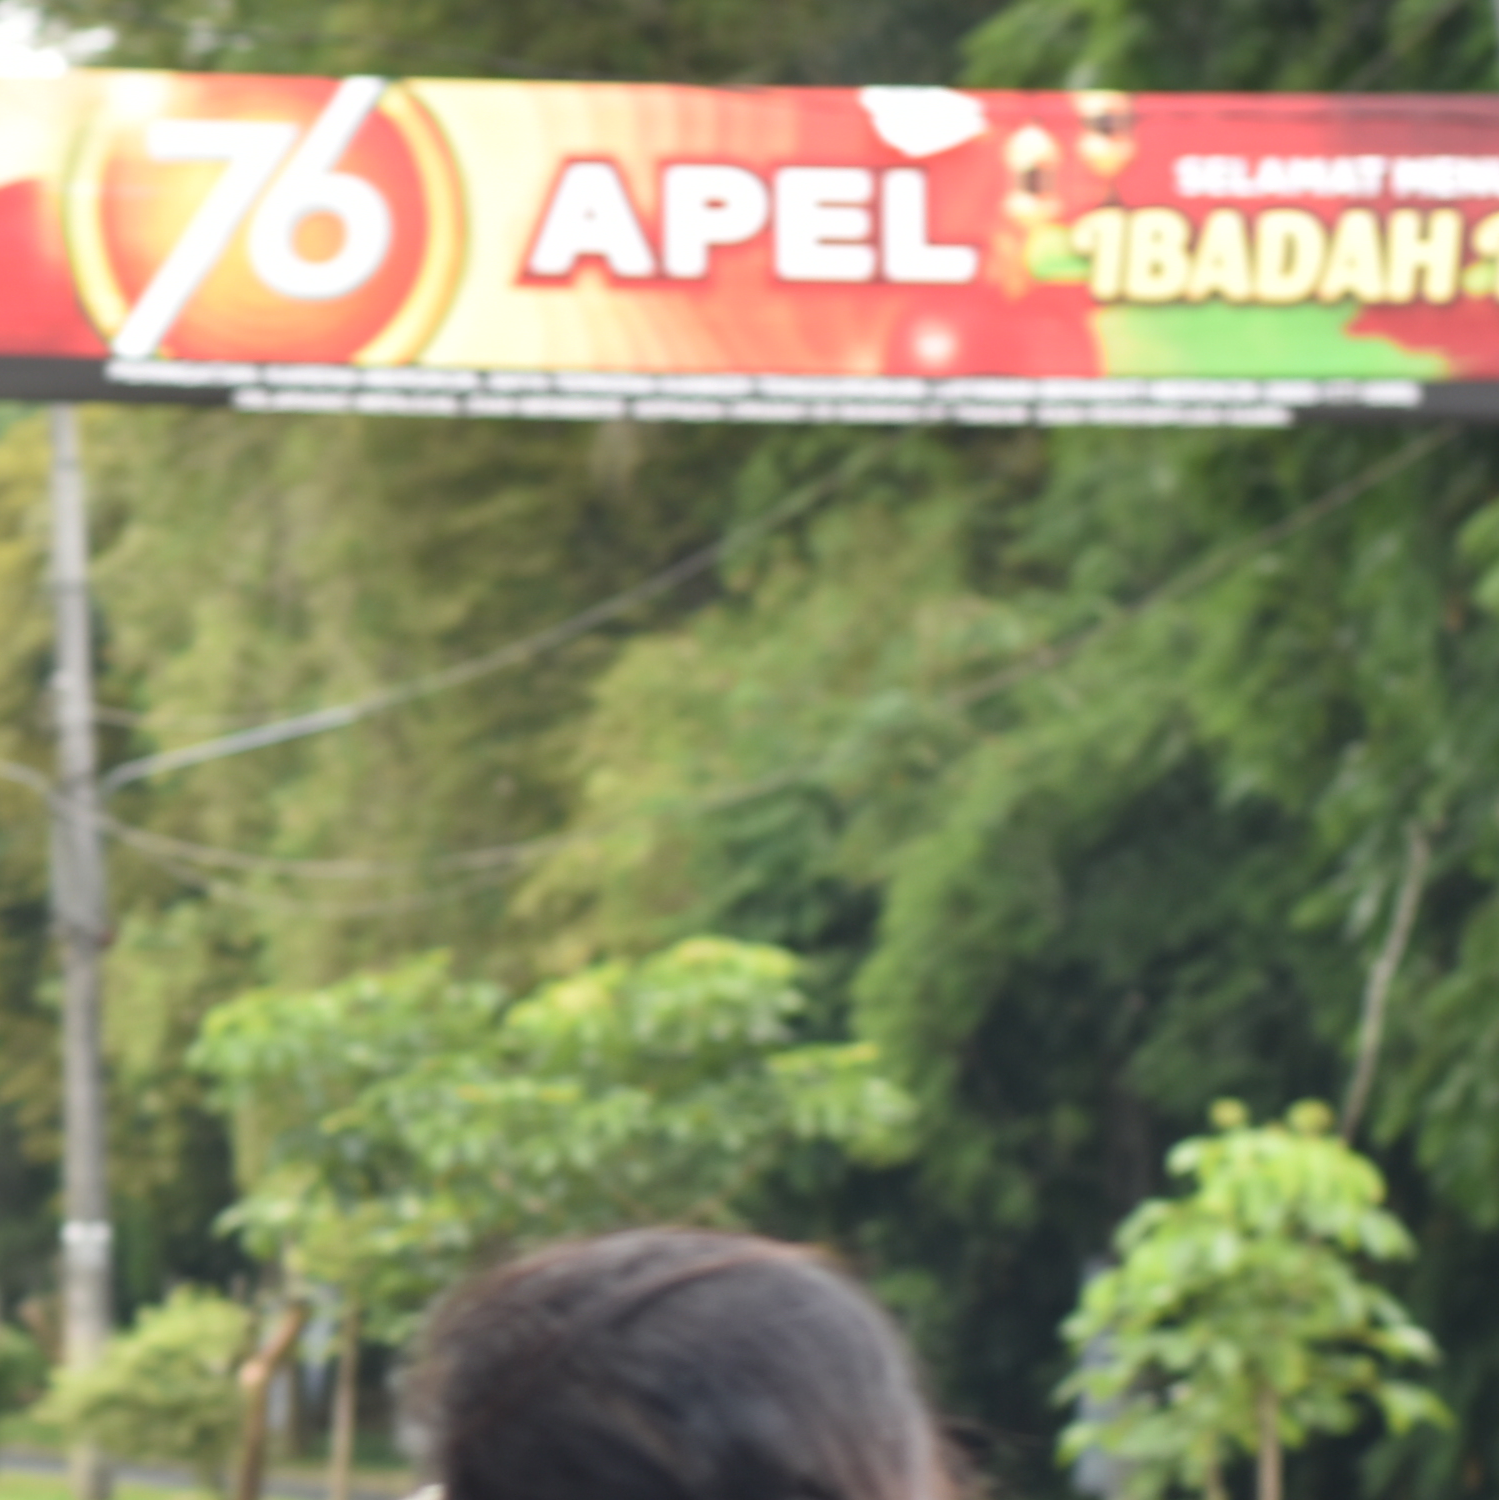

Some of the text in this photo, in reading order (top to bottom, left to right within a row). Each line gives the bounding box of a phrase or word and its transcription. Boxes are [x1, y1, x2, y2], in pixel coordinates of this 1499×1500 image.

[110, 76, 393, 361] 76
[525, 159, 980, 284] APEL
[1175, 154, 1387, 198] SELAMAT
